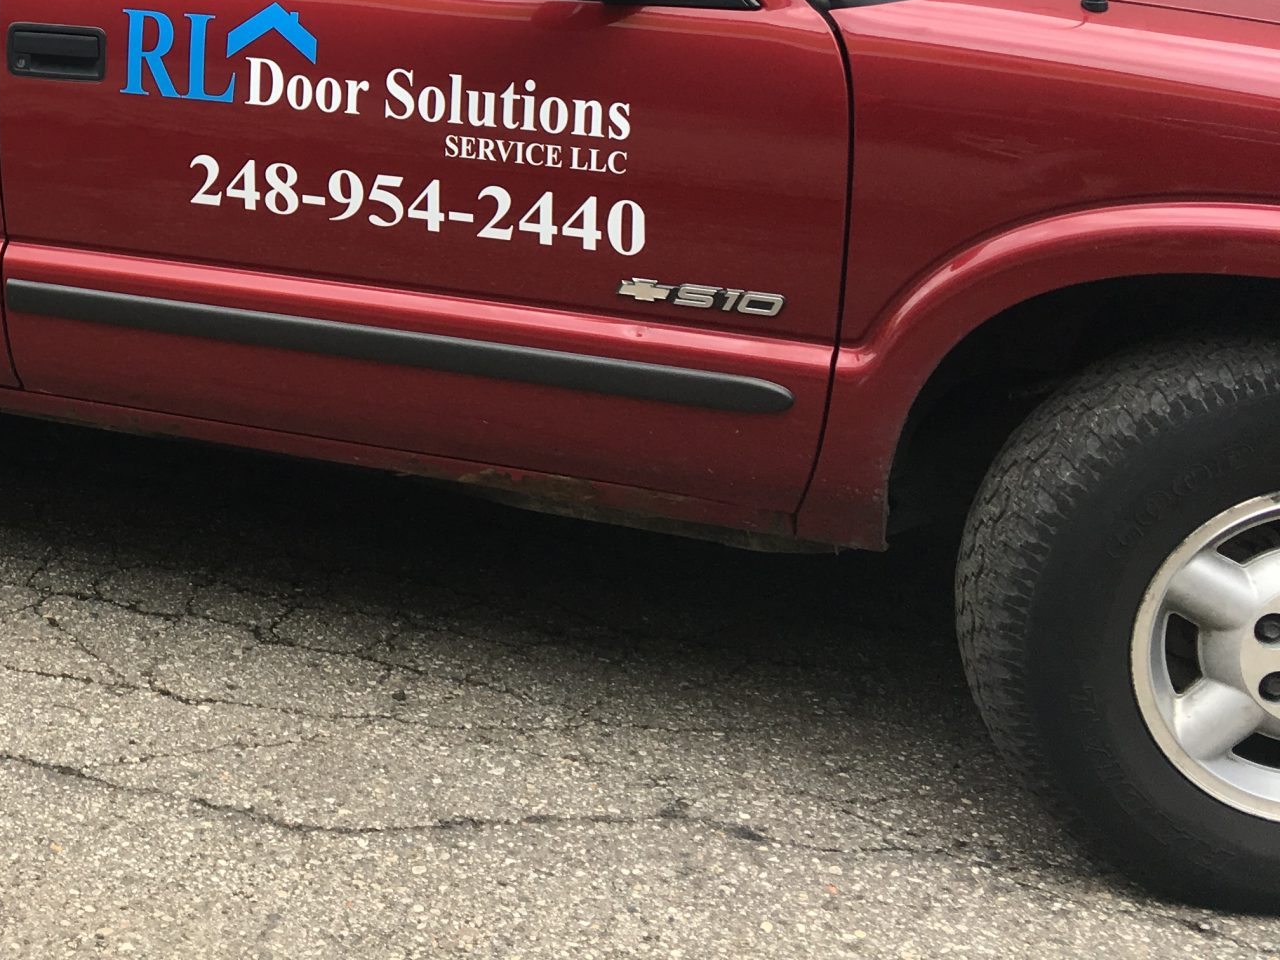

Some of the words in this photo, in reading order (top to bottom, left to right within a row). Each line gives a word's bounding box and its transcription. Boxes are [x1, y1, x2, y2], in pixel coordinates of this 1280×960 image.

[120, 7, 236, 103] RL
[244, 56, 370, 116] Door
[384, 67, 631, 141] Solutions
[444, 135, 563, 169] SERVICE
[569, 147, 629, 175] LLC
[189, 154, 646, 256] 248-954-2440
[673, 283, 786, 317] S10
